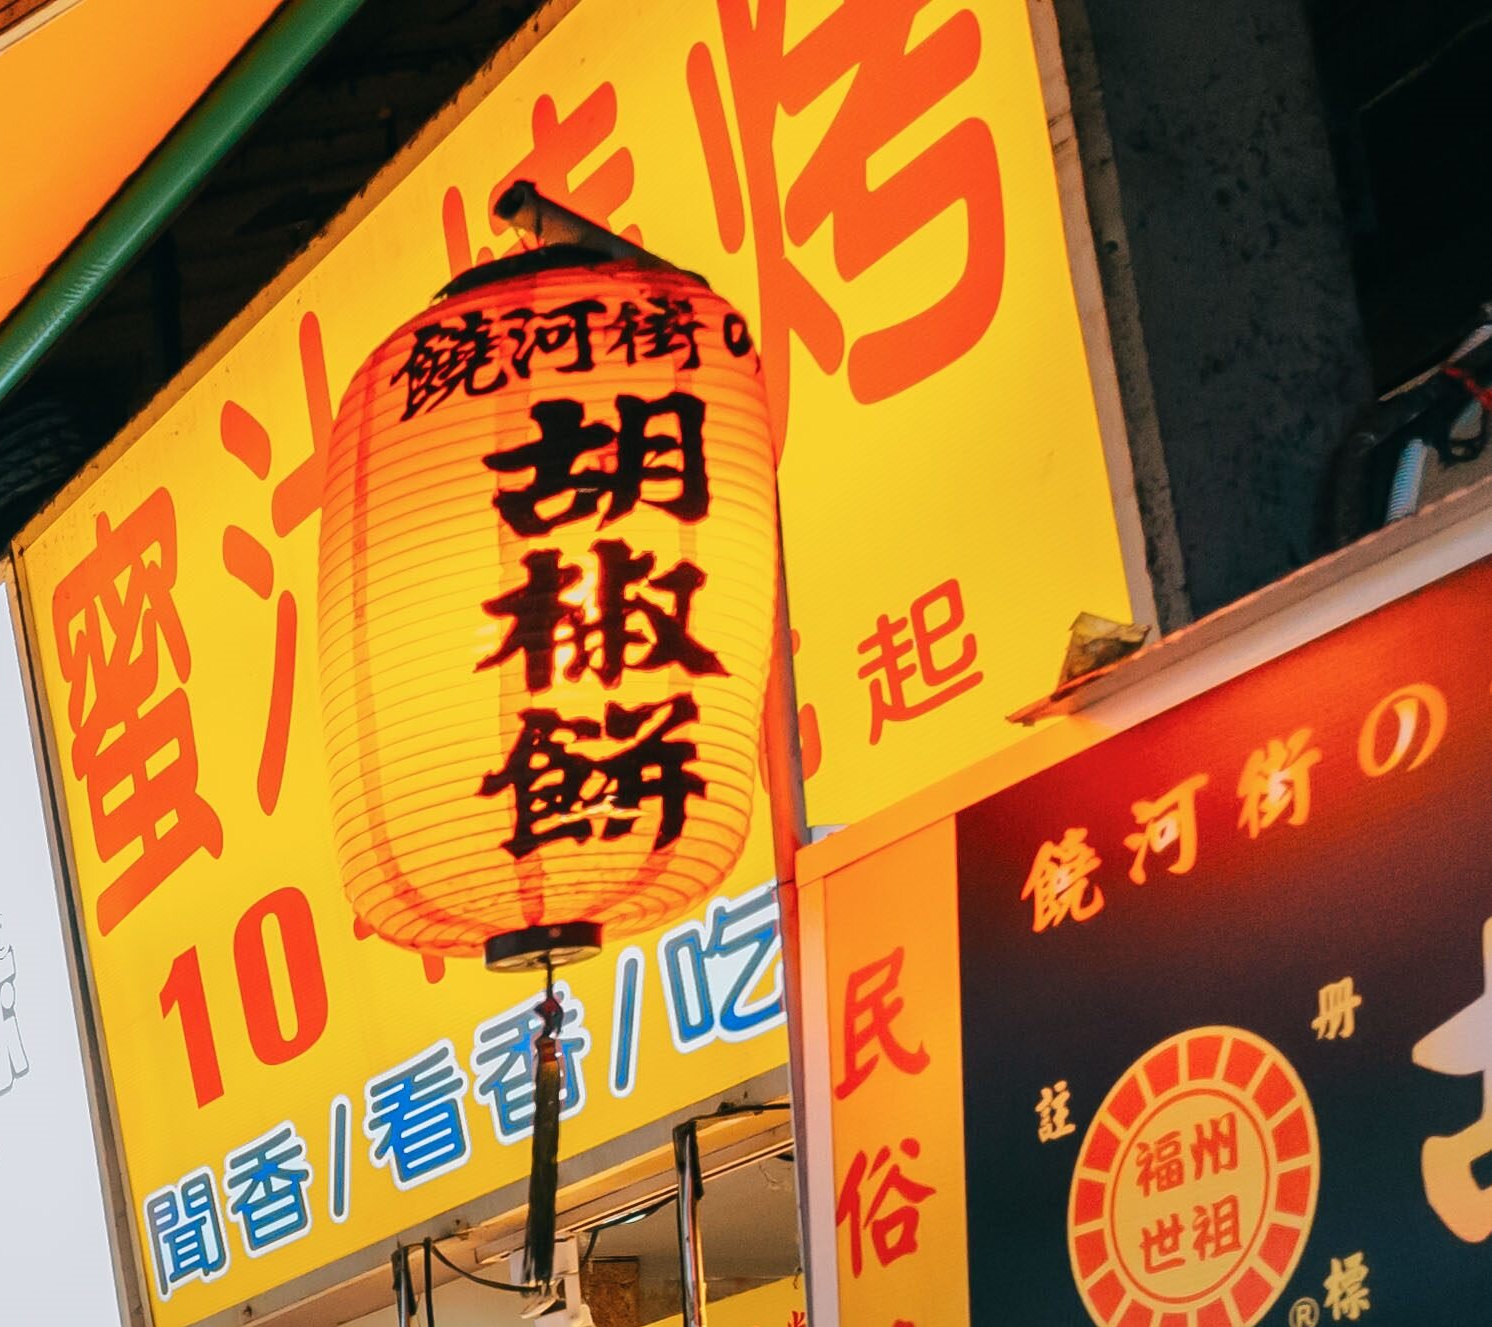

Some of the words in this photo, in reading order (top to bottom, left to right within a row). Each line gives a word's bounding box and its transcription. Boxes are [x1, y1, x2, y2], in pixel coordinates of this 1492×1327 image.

[473, 393, 730, 859] 胡椒餅
[1020, 683, 1448, 933] 饒河街の
[1133, 1111, 1240, 1199] 福州
[1139, 1194, 1244, 1276] 世祖
